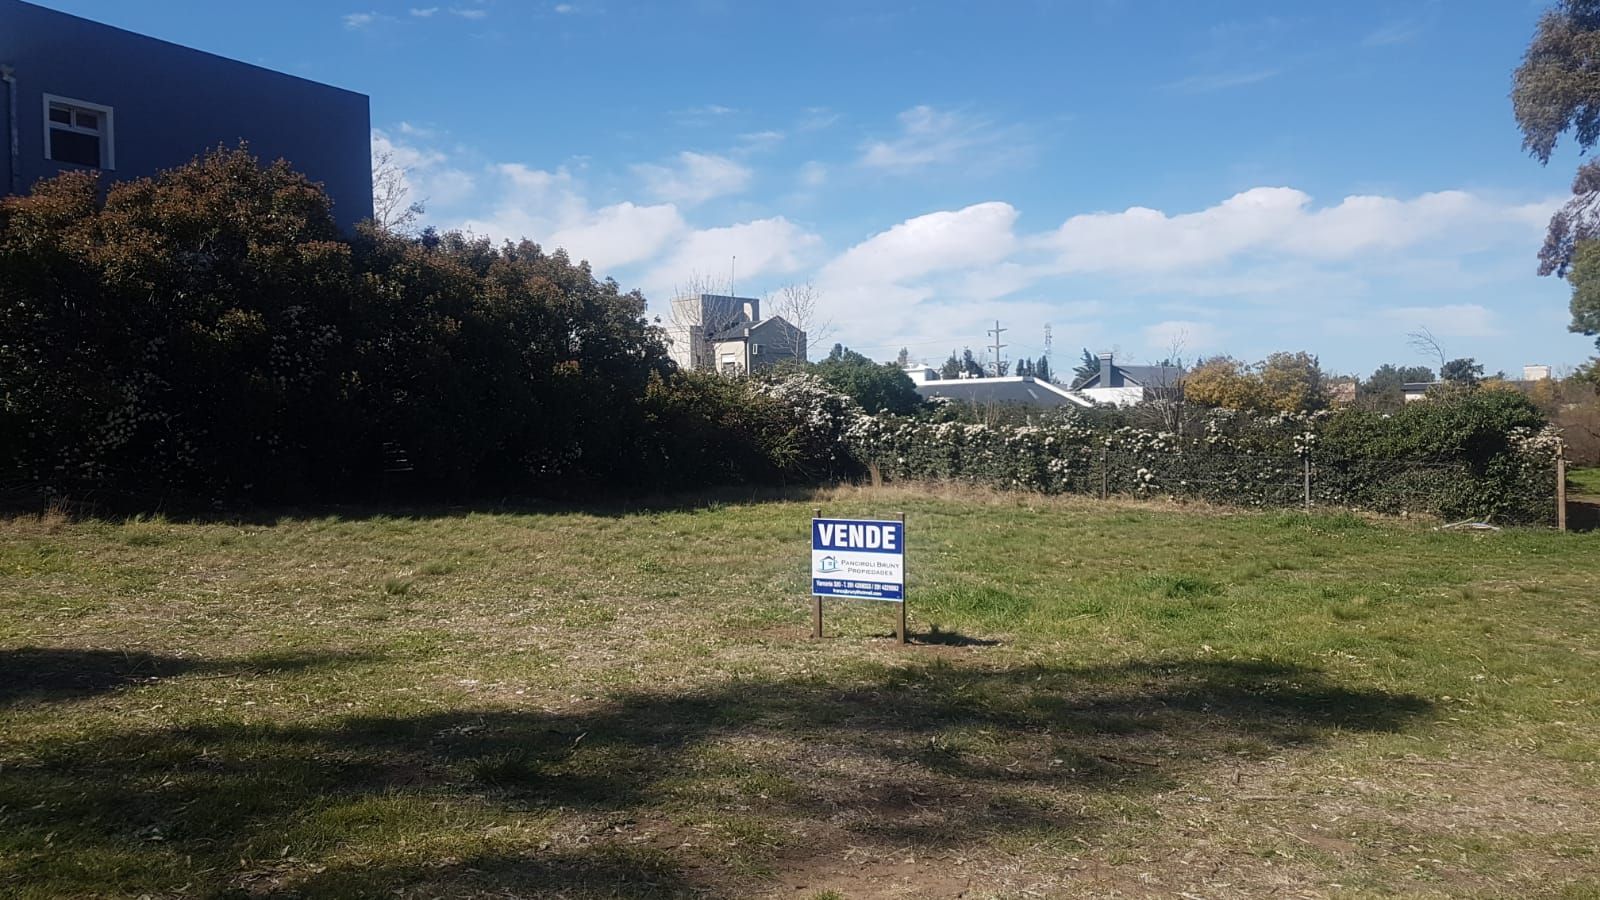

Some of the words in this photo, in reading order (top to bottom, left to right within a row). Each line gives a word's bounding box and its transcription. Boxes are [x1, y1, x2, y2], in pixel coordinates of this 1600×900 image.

[817, 523, 896, 549] VENDE
[841, 559, 876, 568] PANCIROLI
[876, 561, 899, 569] BRUNY
[847, 567, 893, 576] PROPIEDADES
